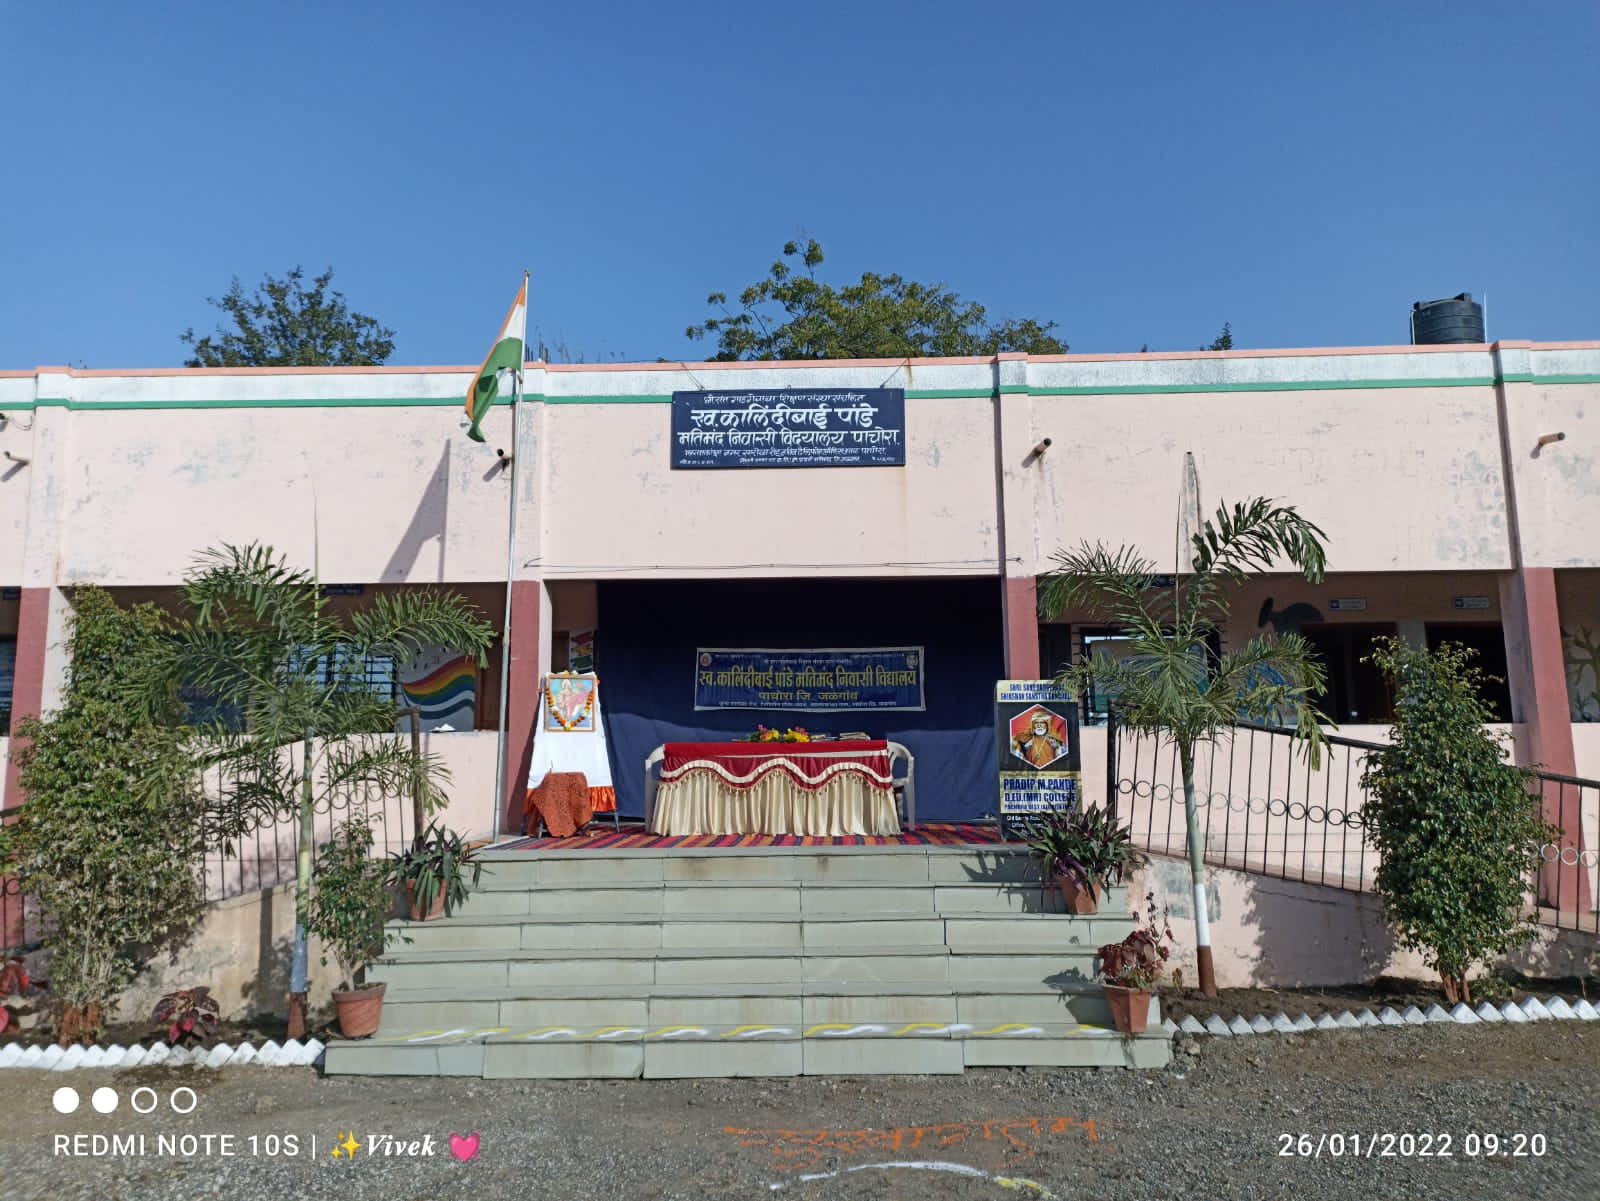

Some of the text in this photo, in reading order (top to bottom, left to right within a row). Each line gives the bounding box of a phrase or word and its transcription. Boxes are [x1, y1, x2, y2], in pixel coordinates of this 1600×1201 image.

[834, 402, 879, 428] पांडे
[677, 427, 726, 447] मतिमंद
[727, 427, 779, 447] निवासी
[775, 666, 793, 688] पांडे
[835, 664, 873, 688] निवासी
[875, 664, 917, 687] विद्यालय
[1004, 779, 1036, 790] PRADIP
